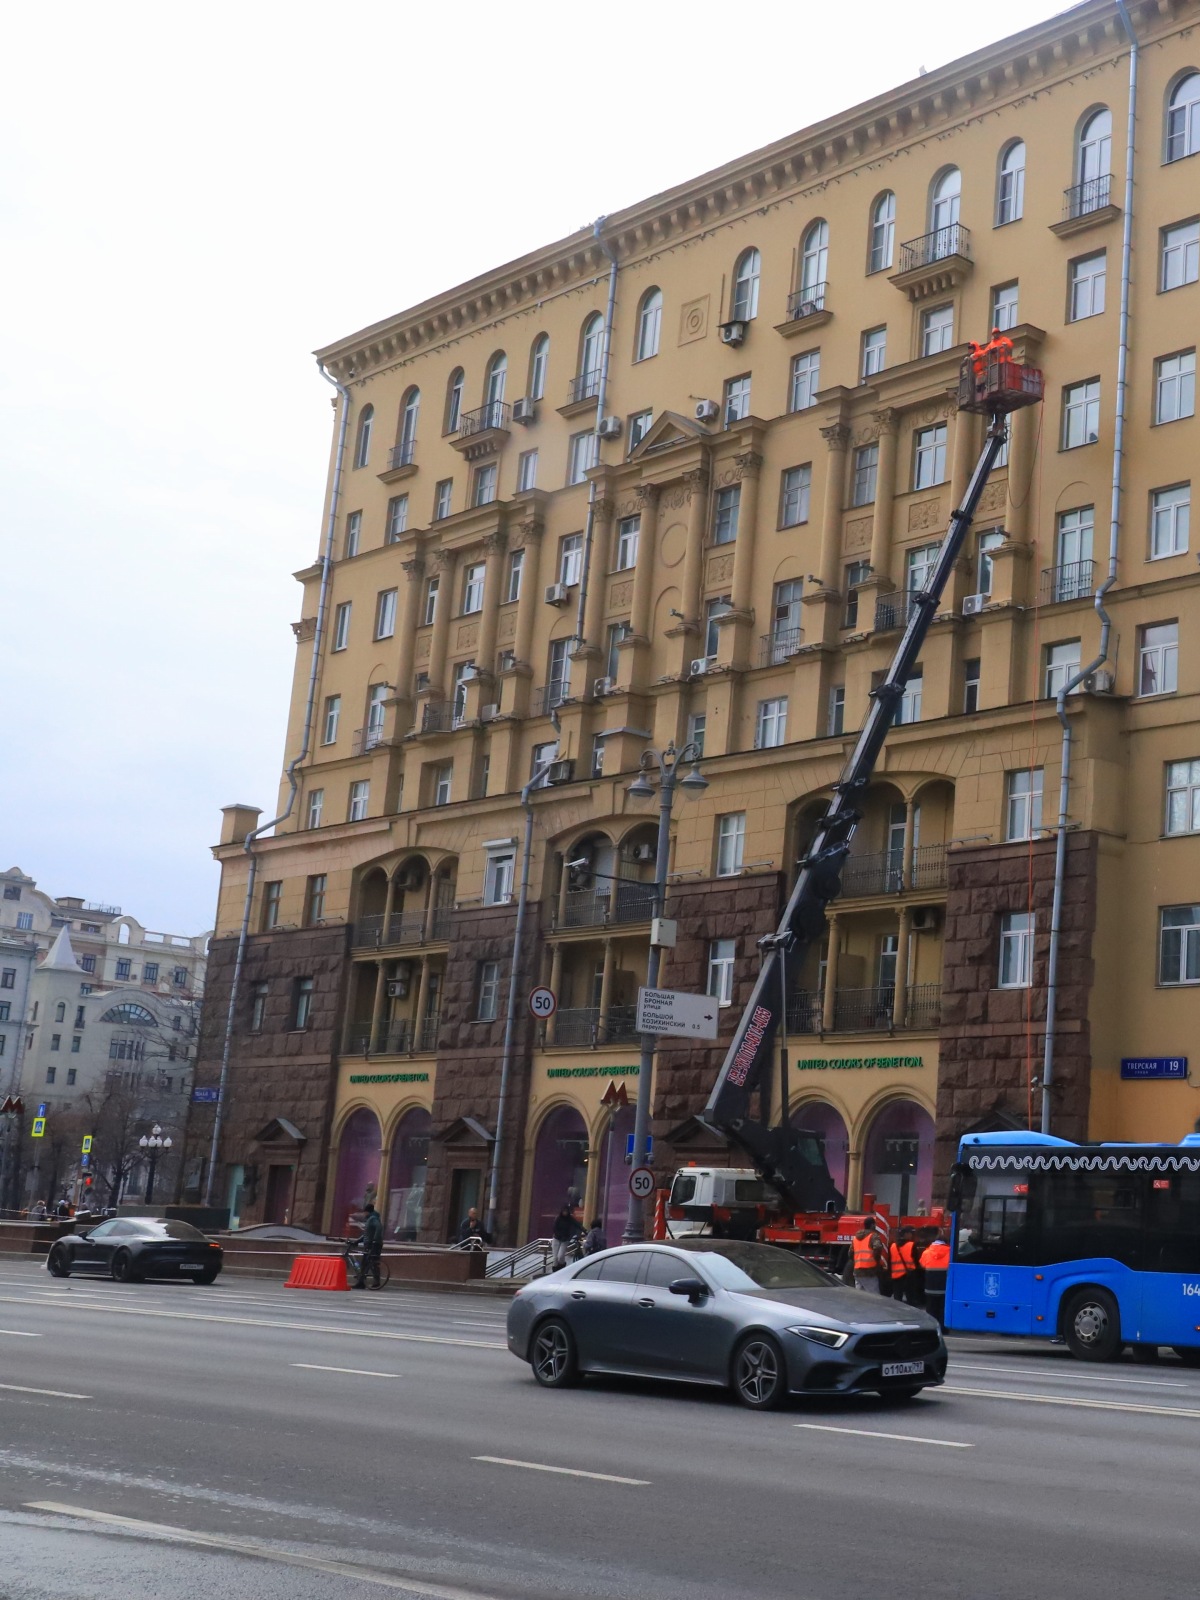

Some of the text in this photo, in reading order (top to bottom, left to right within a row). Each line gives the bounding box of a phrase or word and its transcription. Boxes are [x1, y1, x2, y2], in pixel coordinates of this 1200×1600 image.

[644, 991, 675, 1000] БОЛЬШАЯ
[535, 996, 550, 1010] 50
[643, 998, 673, 1006] БРОННАЯ
[643, 1012, 674, 1020] БОЛЬШОЙ
[642, 1018, 686, 1028] КОЗИХИНСКИЙ
[798, 1059, 828, 1070] UNITED
[829, 1058, 863, 1069] COLORS
[864, 1058, 877, 1068] OF
[1127, 1061, 1179, 1071] ТВЕРСКАЯ 19
[547, 1068, 571, 1078] UNITED
[572, 1067, 598, 1077] COLORS
[608, 1065, 640, 1076] BENETTO
[635, 1177, 650, 1190] 50
